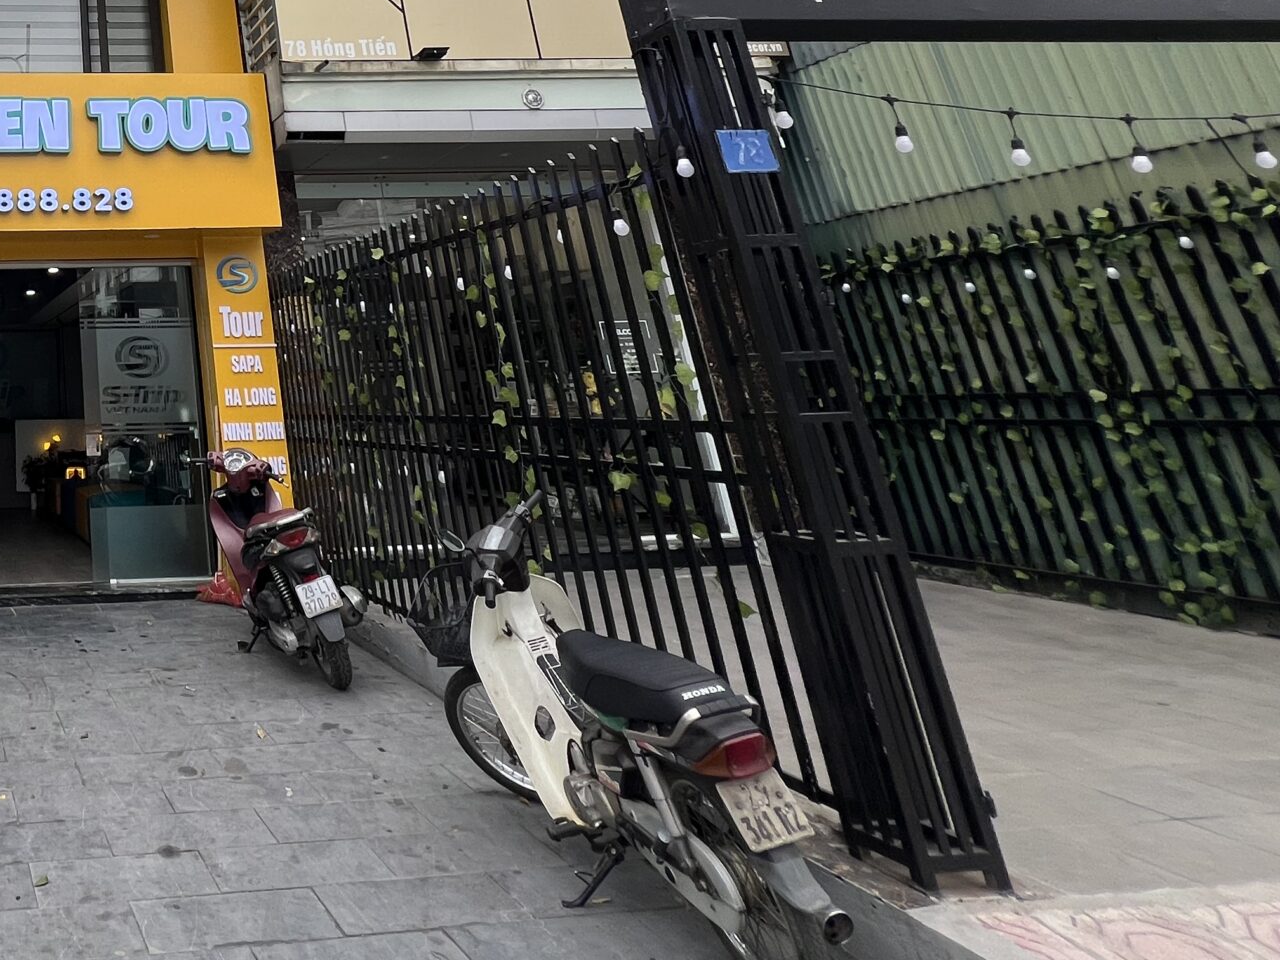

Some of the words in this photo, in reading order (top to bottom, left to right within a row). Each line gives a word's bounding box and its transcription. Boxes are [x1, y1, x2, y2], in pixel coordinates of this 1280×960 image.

[284, 40, 307, 57] 78
[86, 97, 254, 154] TOUR
[218, 305, 263, 337] Tour
[231, 354, 263, 373] SAPA
[224, 387, 242, 406] HA
[244, 386, 277, 406] LONG
[222, 422, 253, 441] NINH
[254, 421, 285, 441] BINH
[681, 684, 726, 701] HONDA
